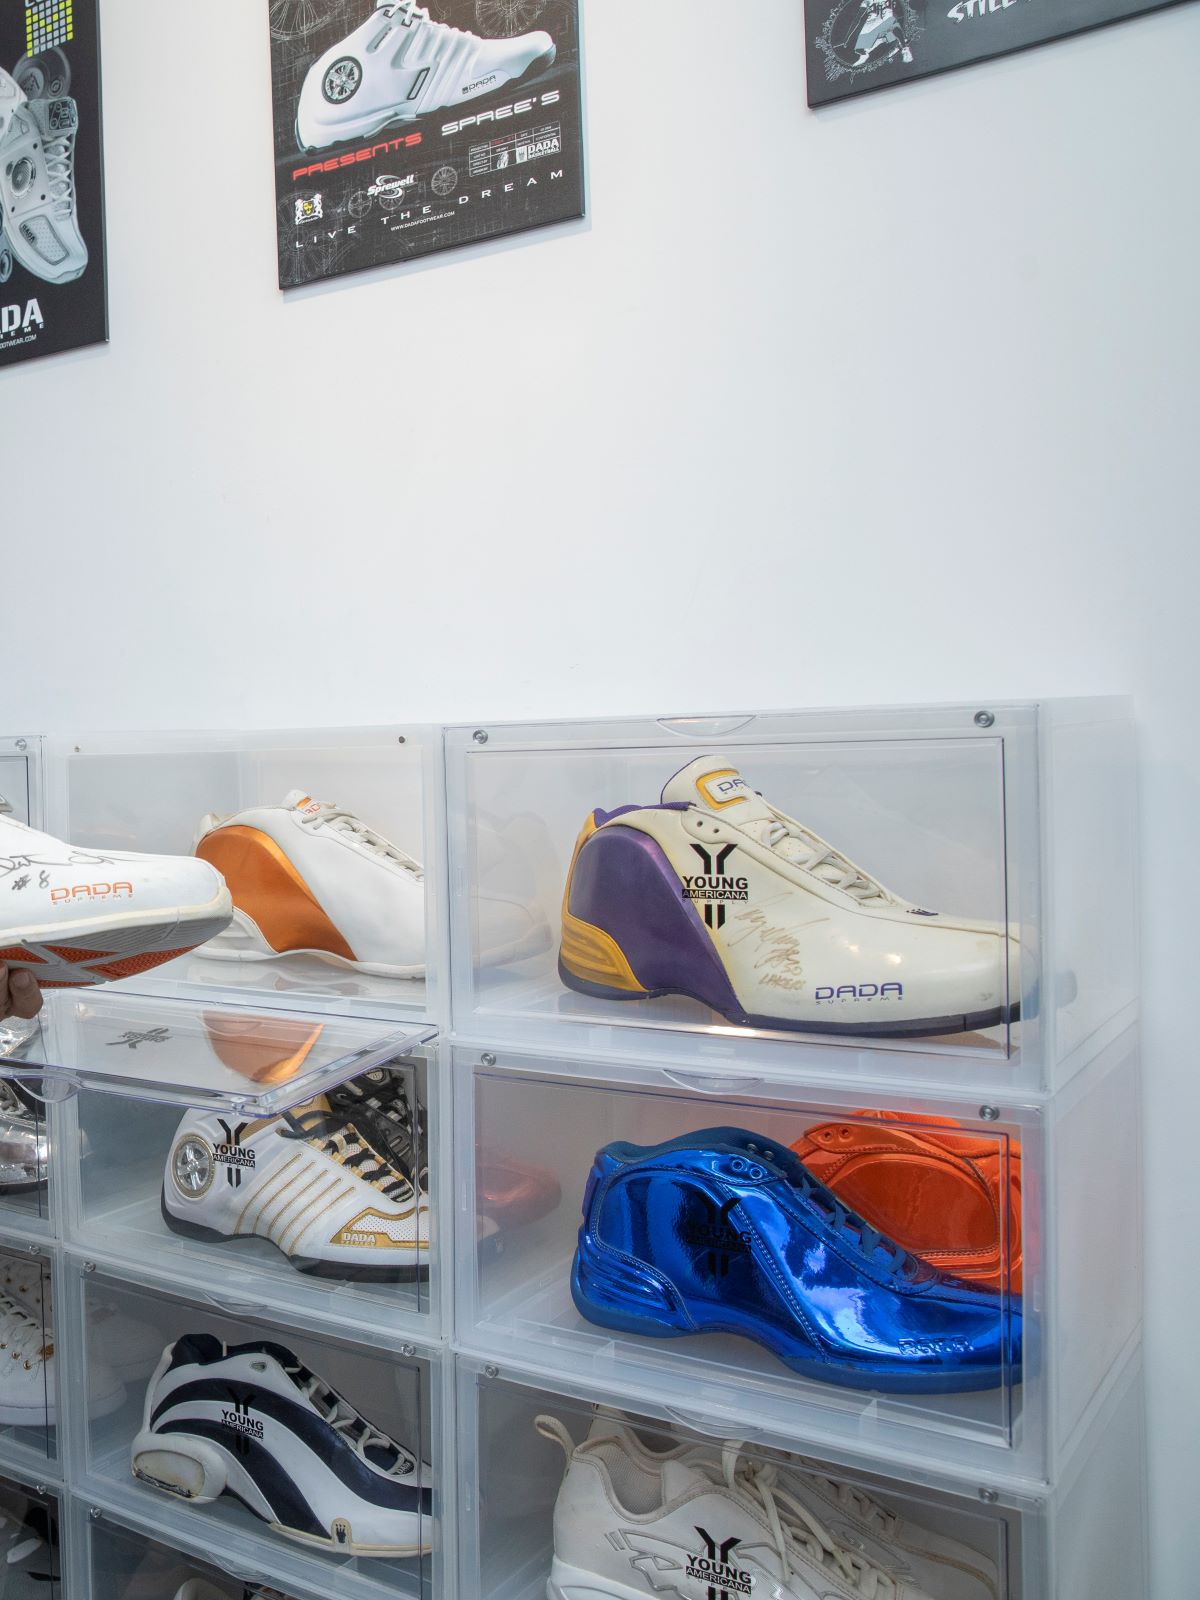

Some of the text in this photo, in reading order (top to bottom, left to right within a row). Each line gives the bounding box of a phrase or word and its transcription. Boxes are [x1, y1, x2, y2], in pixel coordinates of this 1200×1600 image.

[468, 74, 497, 92] DADA
[441, 90, 561, 136] SPREE'S
[528, 138, 560, 153] DADA
[291, 132, 423, 181] PRESENTS
[367, 173, 415, 197] Sprewell
[295, 169, 564, 249] LIVE THE DREAM
[390, 210, 455, 231] WWW.DADAFOOTWEAR.COM
[51, 881, 133, 901] DADA
[682, 876, 748, 890] YOUNG
[682, 889, 748, 900] AMERICANA
[815, 982, 903, 1000] DADA
[212, 1142, 256, 1159] YOUNG
[212, 1153, 256, 1168] AMERICANA
[343, 1232, 376, 1241] DADA
[221, 1409, 264, 1431] YOUNG
[686, 1553, 752, 1584] YOUNG
[686, 1565, 752, 1595] AMERICANA
